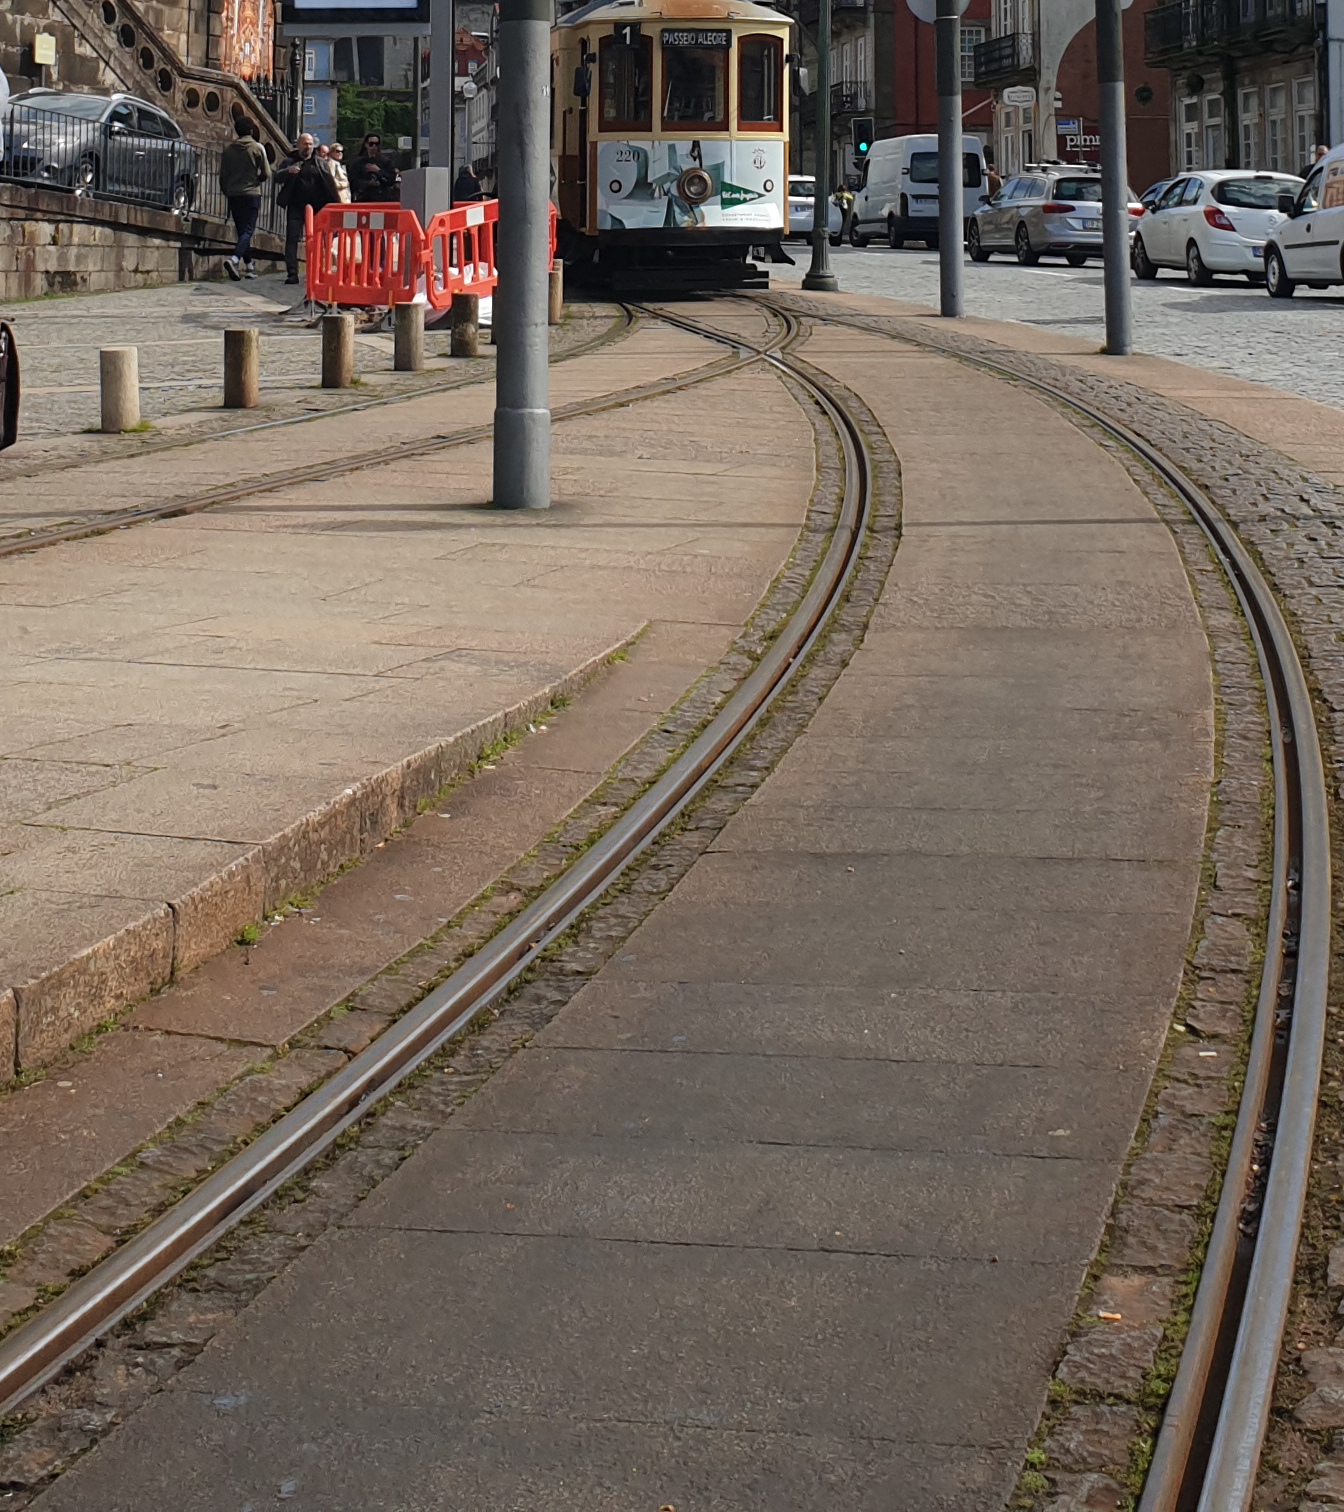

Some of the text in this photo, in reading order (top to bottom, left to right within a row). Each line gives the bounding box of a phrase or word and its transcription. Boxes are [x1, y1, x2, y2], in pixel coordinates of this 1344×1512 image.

[622, 26, 631, 45] 1
[663, 32, 727, 45] PASSEIO ALEGRE
[616, 150, 640, 163] 220
